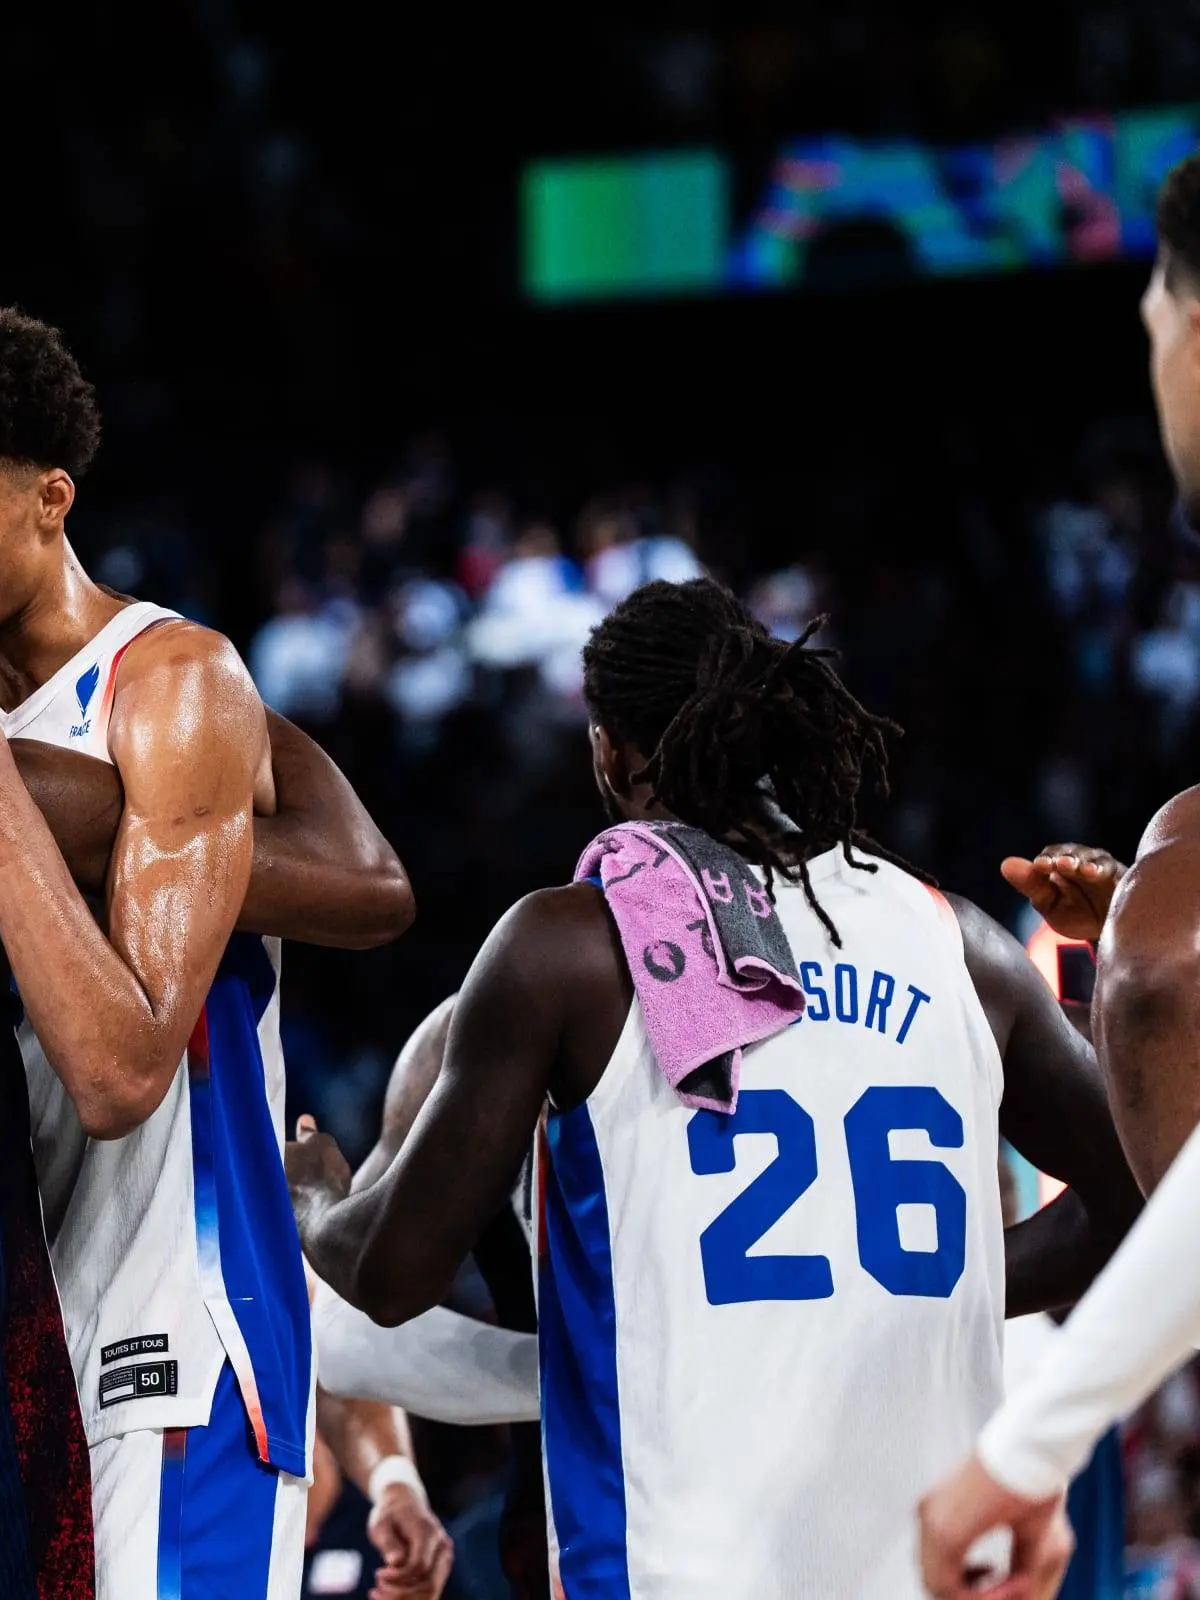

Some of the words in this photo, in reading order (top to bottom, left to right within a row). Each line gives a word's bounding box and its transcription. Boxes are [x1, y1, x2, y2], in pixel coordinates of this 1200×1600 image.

[789, 961, 931, 1044] SORT
[686, 1086, 967, 1305] 26
[104, 1344, 128, 1359] TOUTES
[130, 1342, 139, 1351] ET
[142, 1339, 164, 1349] TOUS
[141, 1372, 160, 1386] 50
